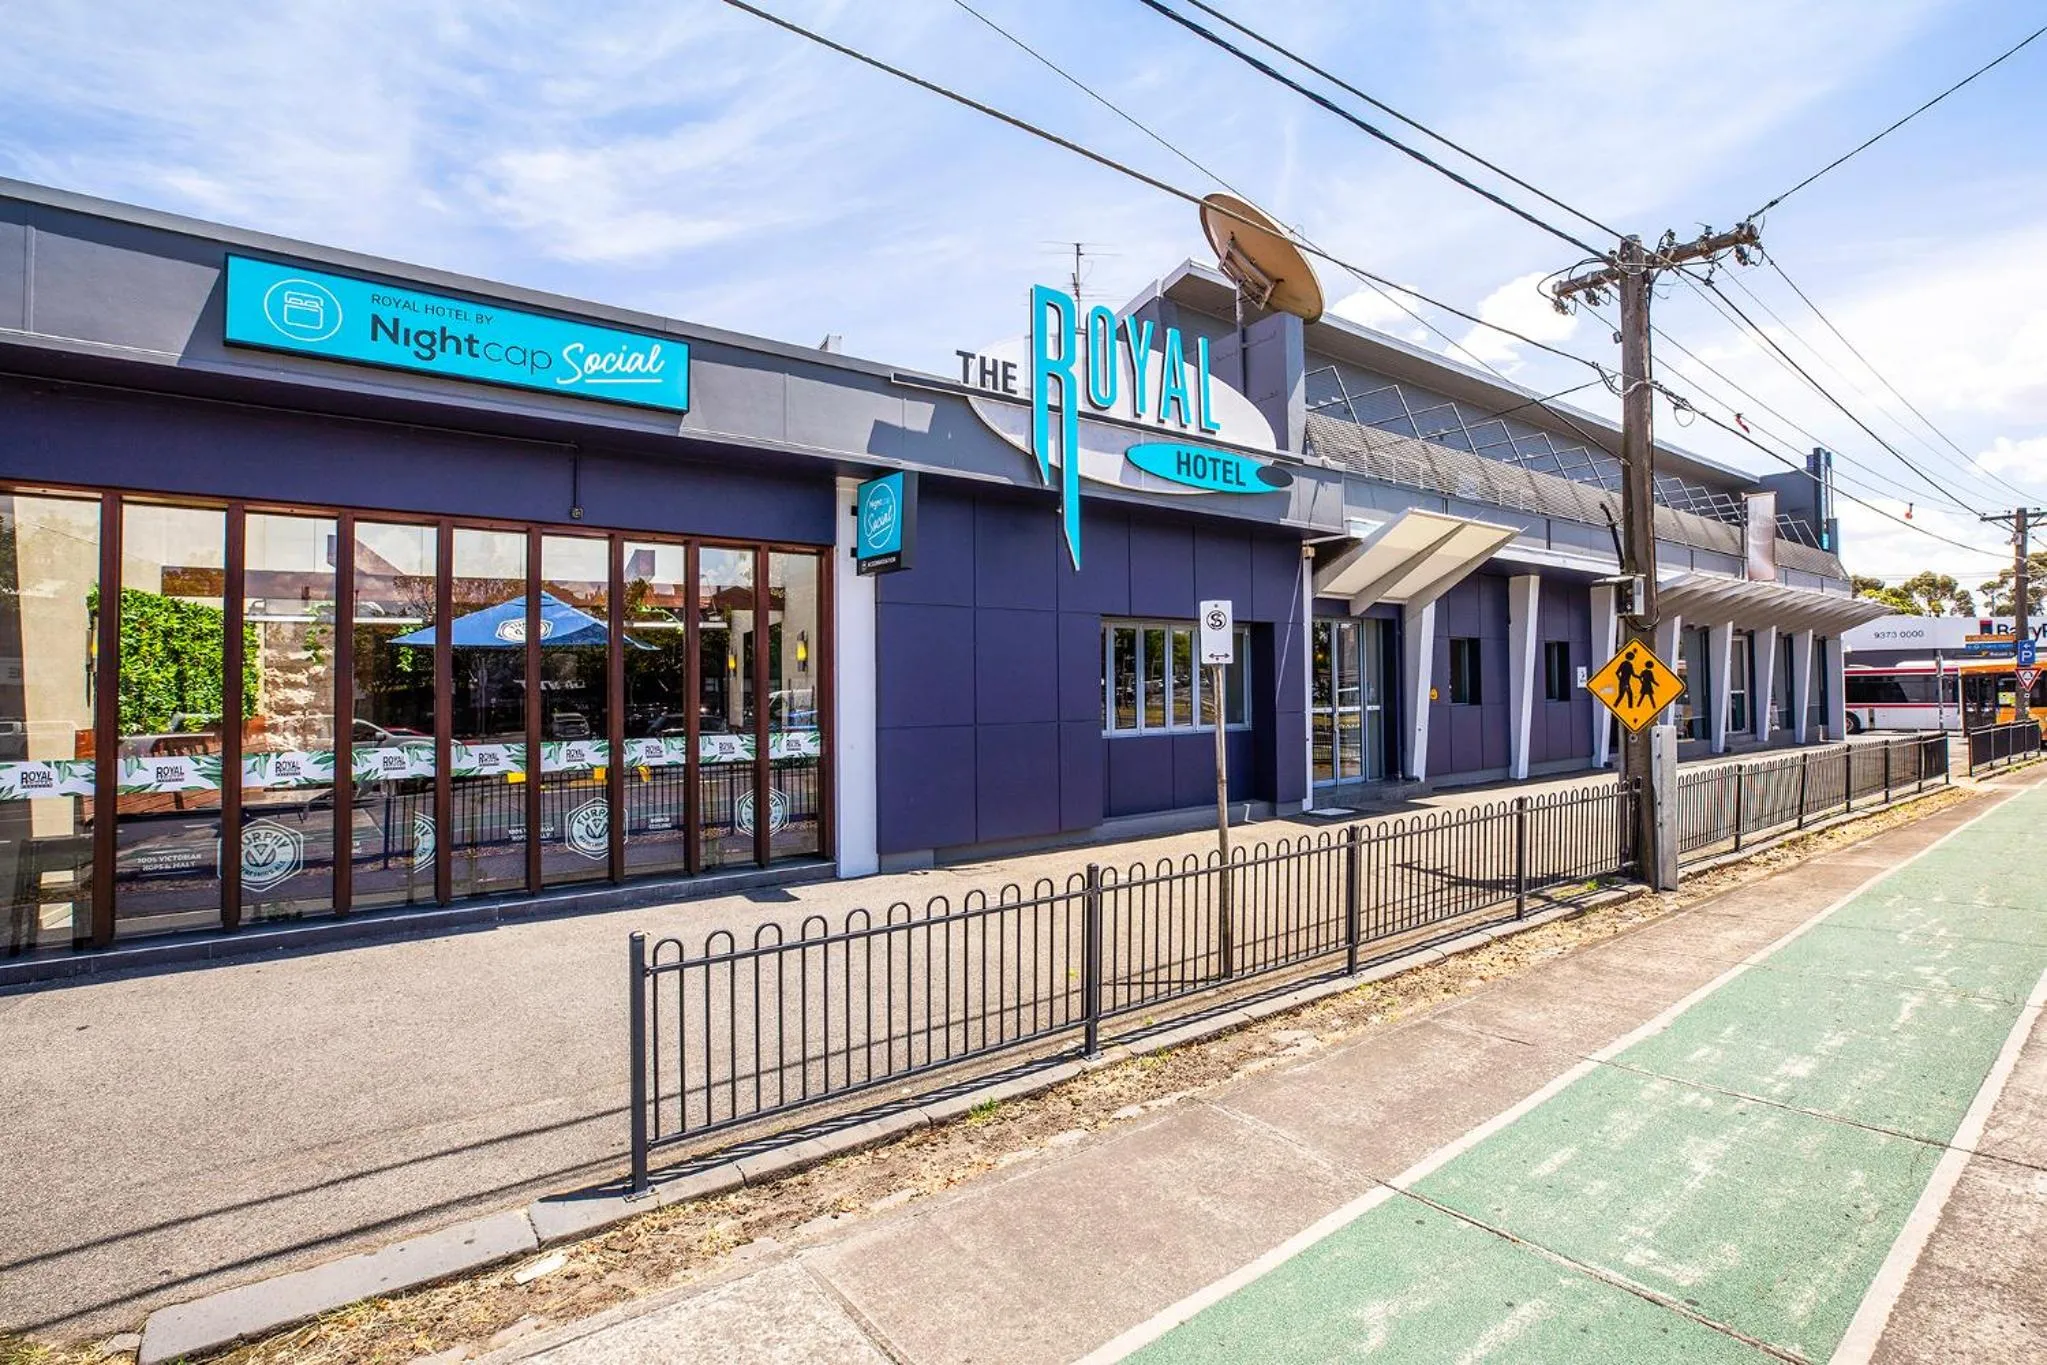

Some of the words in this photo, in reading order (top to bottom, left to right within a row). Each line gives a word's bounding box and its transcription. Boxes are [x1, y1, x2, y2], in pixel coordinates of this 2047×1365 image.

[371, 294, 419, 313] ROYAL
[424, 303, 470, 322] HOTEL
[475, 312, 494, 325] BY
[370, 312, 553, 375] Nightcap
[556, 342, 665, 385] Social
[956, 349, 1018, 395] THE
[1030, 284, 1221, 571] ROYAL
[1176, 449, 1247, 487] HOTEL
[1873, 631, 1898, 640] 9373
[1899, 630, 1924, 639] 0000
[2021, 650, 2033, 662] P
[156, 765, 185, 779] ROYAL
[275, 760, 301, 774] ROYAL
[21, 770, 53, 785] ROYAL
[576, 807, 609, 827] FURP
